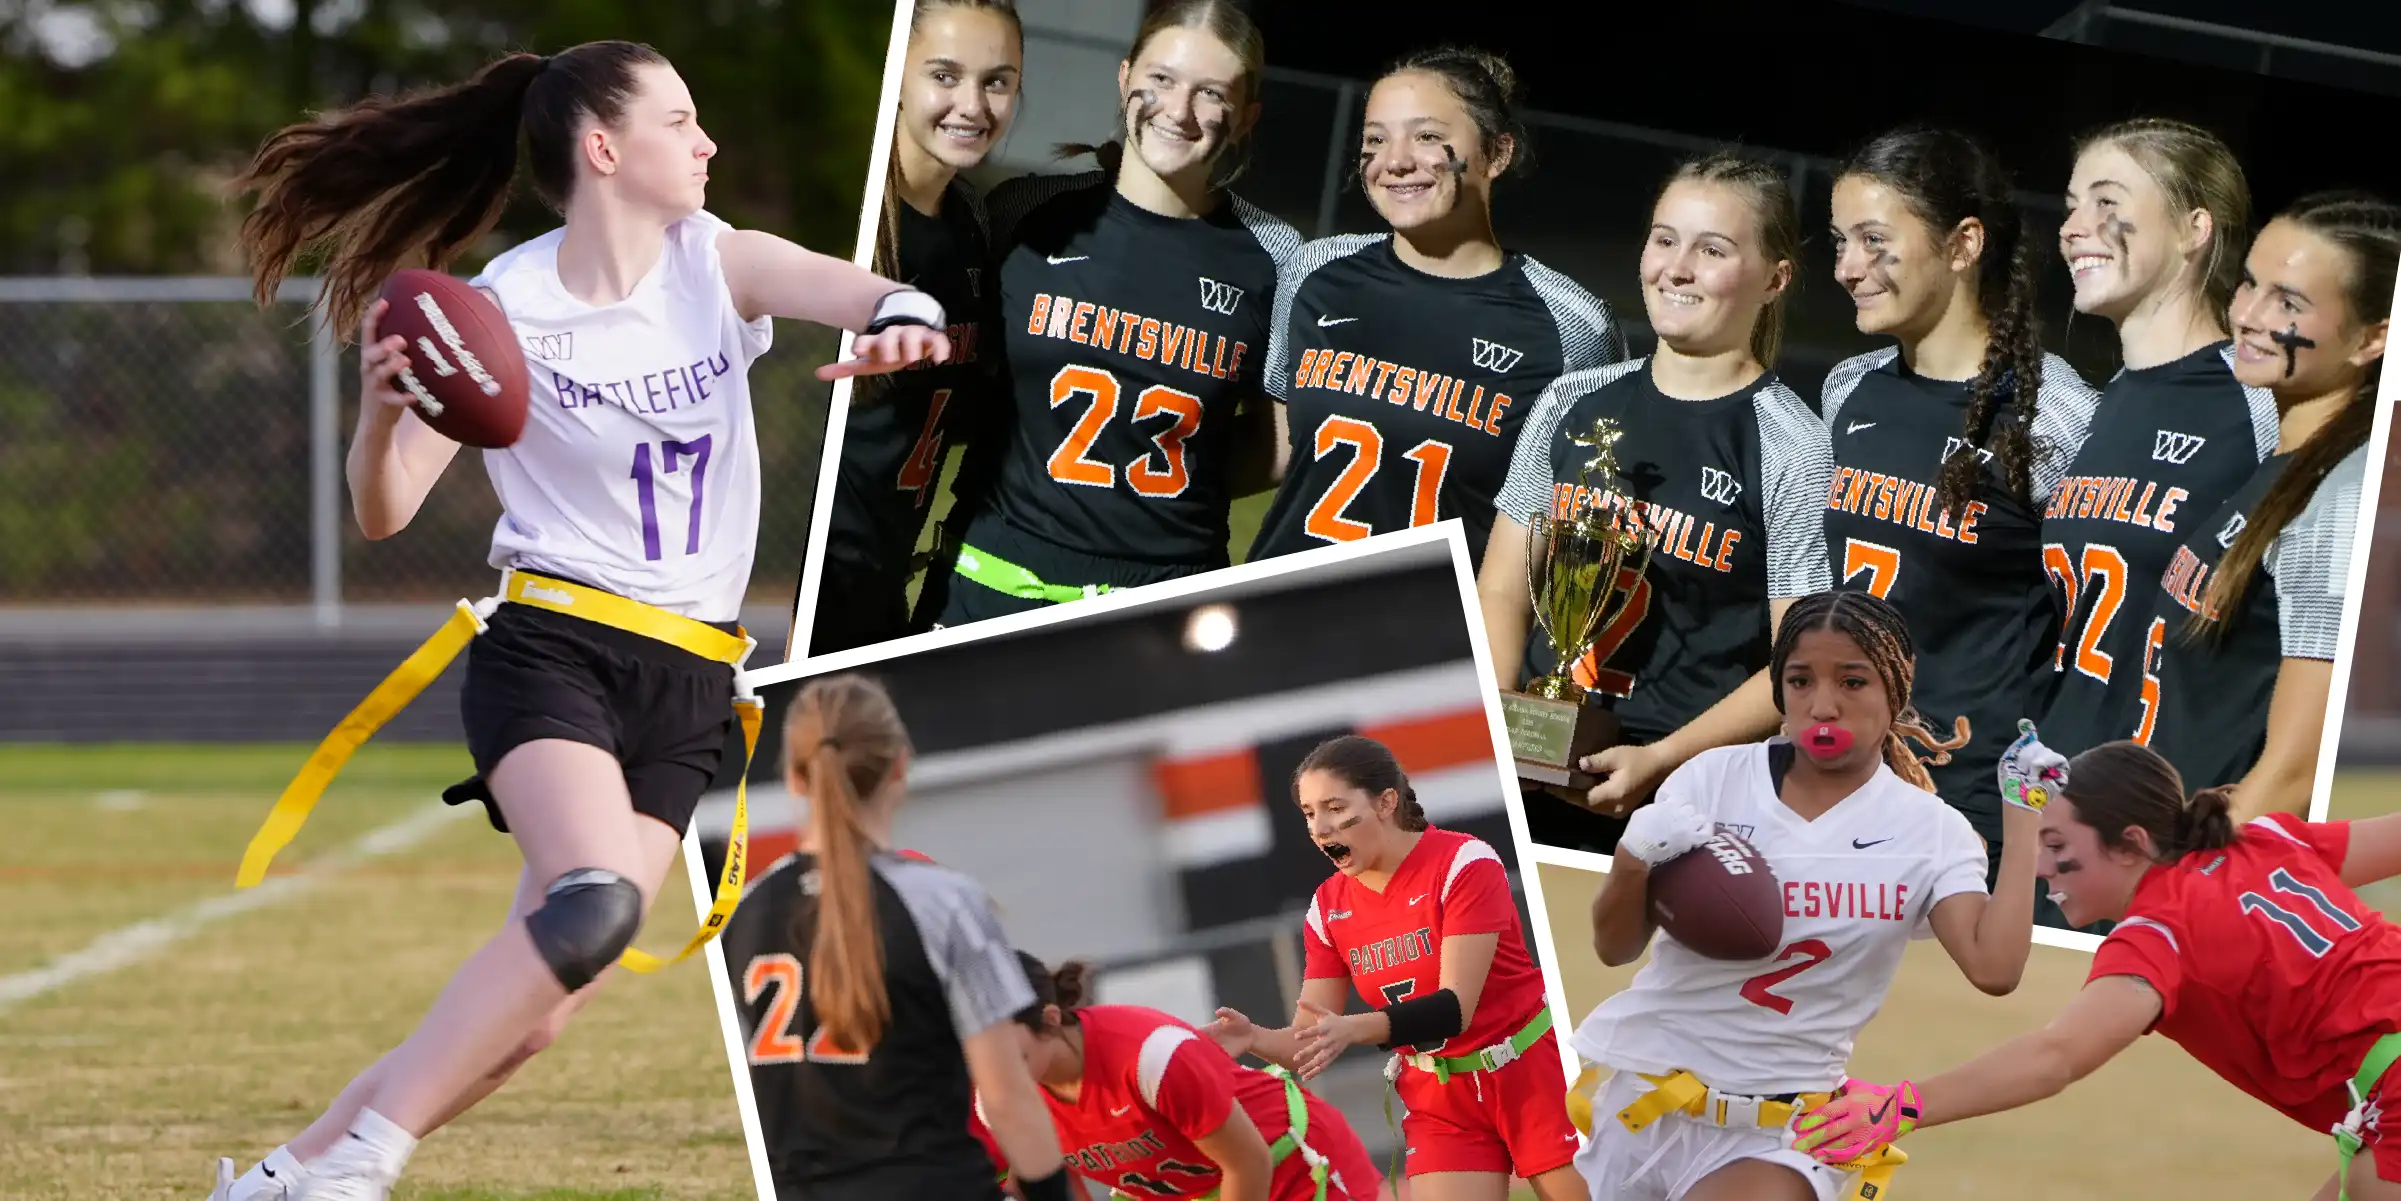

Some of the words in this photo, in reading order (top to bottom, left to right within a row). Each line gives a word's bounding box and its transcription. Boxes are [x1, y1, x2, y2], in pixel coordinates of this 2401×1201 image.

[1028, 293, 1248, 383] BRENTSVILLE
[1047, 363, 1204, 498] 23
[1296, 348, 1512, 437] BRENTSVILLE
[897, 388, 952, 509] 4
[1304, 414, 1453, 544] 21
[631, 433, 712, 562] 17
[1829, 465, 1989, 545] ENTSVILLE
[2045, 475, 2190, 533] ENTSVILLE
[1842, 537, 1901, 601] 7
[1783, 881, 1908, 921] ESVILLE
[2237, 866, 2363, 959] 11
[1349, 926, 1433, 977] PATRIOT
[1739, 938, 1833, 1016] 2
[743, 952, 870, 1066] 2
[1063, 1128, 1166, 1172] PATRIOT
